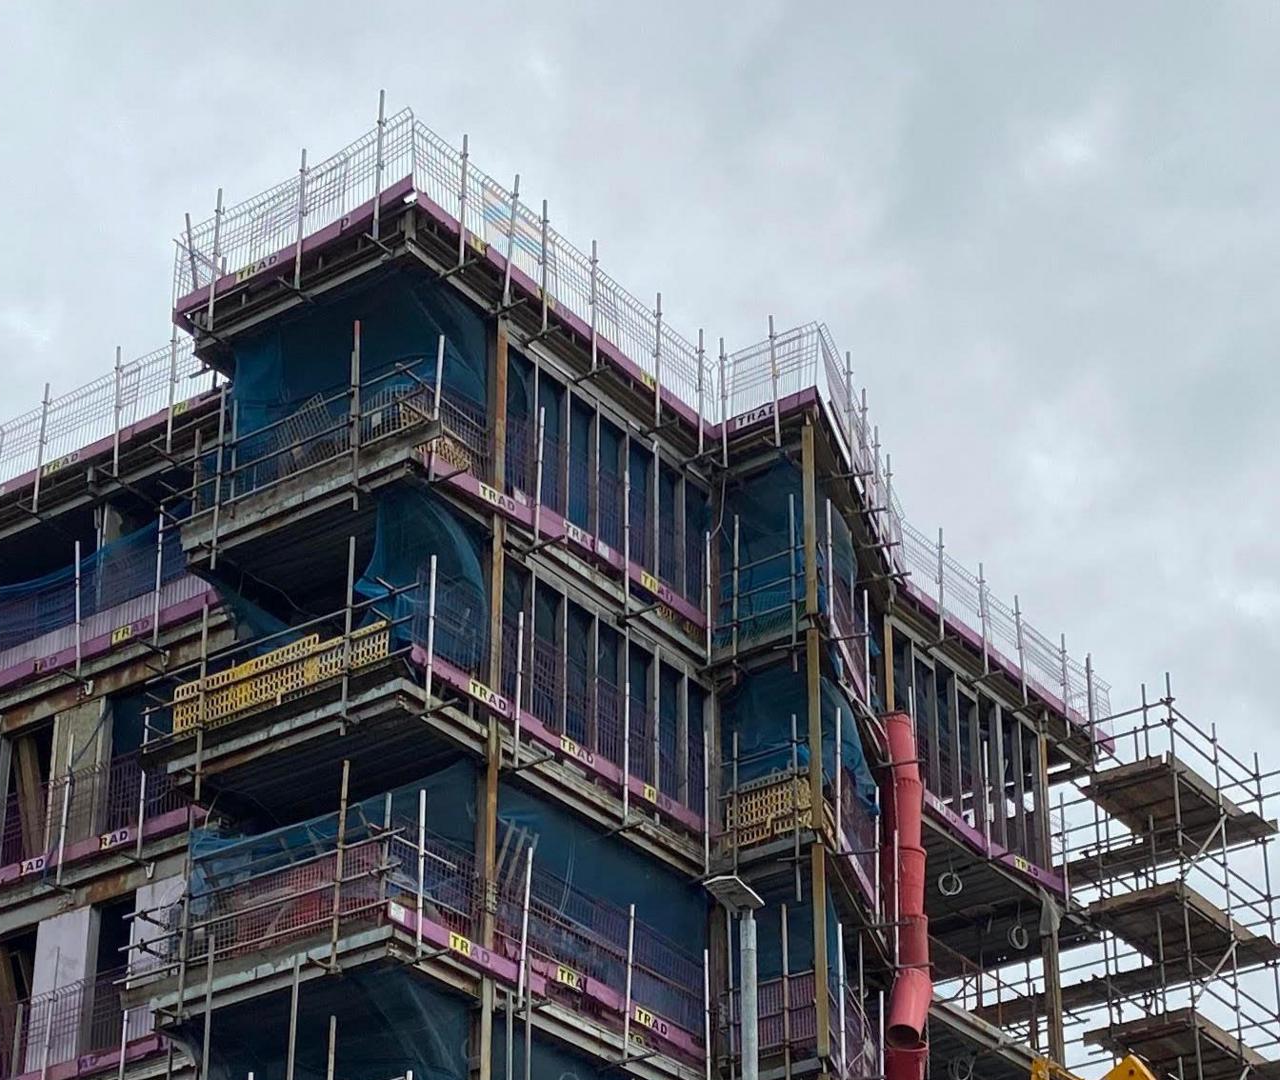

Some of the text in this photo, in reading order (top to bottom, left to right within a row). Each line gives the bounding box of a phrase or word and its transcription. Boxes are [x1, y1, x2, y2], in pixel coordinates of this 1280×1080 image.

[238, 255, 277, 280] TRAD
[44, 452, 79, 476] TRAD
[481, 484, 515, 512] TRAD
[113, 620, 149, 641] TRAD
[470, 682, 508, 713] TRAD
[560, 736, 595, 765] TRAD
[1015, 857, 1039, 876] TRAD
[450, 934, 489, 963] TRAD
[636, 1008, 667, 1036] TRAD
